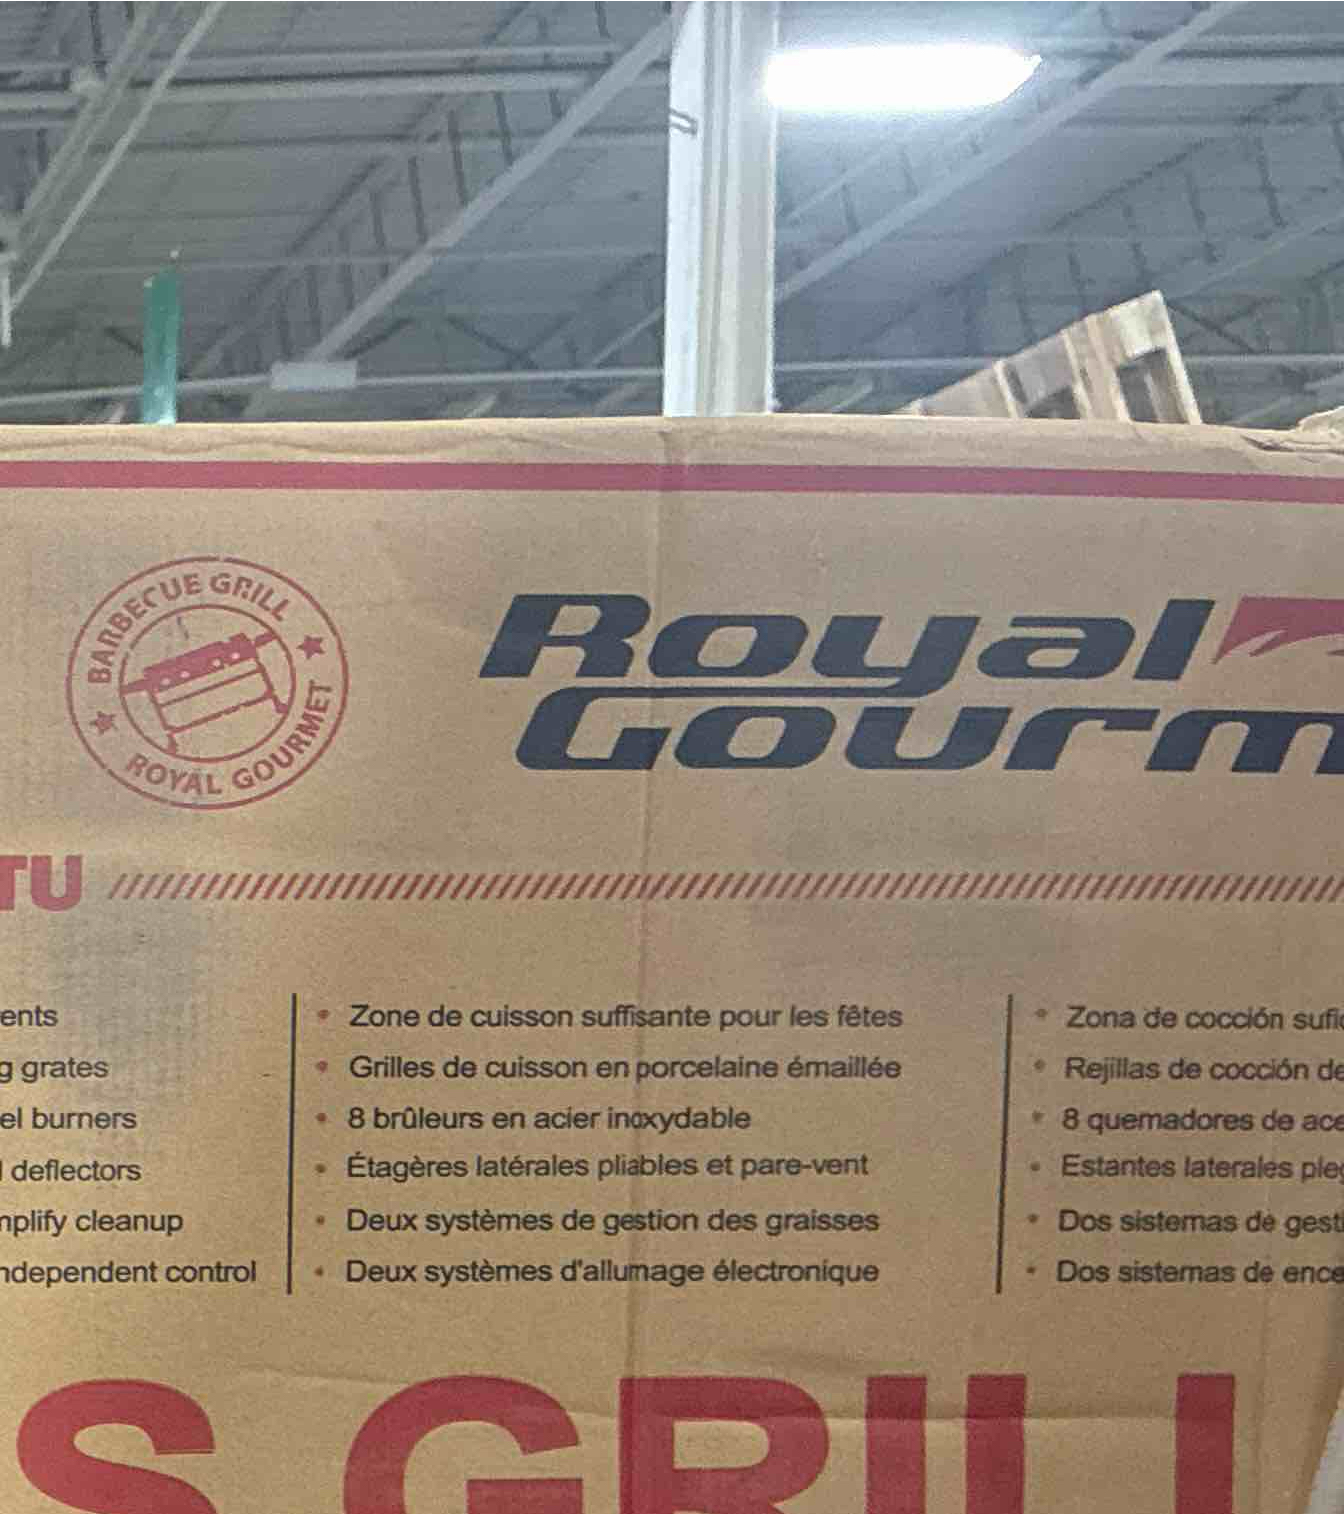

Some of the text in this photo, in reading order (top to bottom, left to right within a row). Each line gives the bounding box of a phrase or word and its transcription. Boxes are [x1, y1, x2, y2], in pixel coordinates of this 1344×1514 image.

[88, 571, 291, 684] BARBECUE GRILL
[479, 593, 1216, 698] Royal
[124, 680, 333, 796] ROYAL GOURMET
[515, 686, 1344, 774] Gourm
[350, 1004, 904, 1031] Zone de cuisson suffisante pour les fêtes
[1067, 1005, 1136, 1029] Zona
[1143, 1006, 1177, 1029] de
[1185, 1006, 1284, 1030] cocción
[22, 1057, 109, 1083] grates
[350, 1056, 902, 1083] Grilles de cuisson en porcelaine émaillée
[1065, 1057, 1161, 1086] Rejillas
[1168, 1057, 1202, 1080] de
[1210, 1057, 1309, 1081] cocción
[32, 1108, 137, 1130] burners
[348, 1106, 752, 1134] 8 brûleurs en acier inoxydable
[1062, 1108, 1080, 1130] 8
[1087, 1108, 1254, 1135] quemadores
[1262, 1108, 1295, 1131] de
[12, 1159, 142, 1182] deflectors
[347, 1151, 869, 1183] Étagères latérales pliables et pare-vent
[1061, 1154, 1176, 1179] Estantes
[1184, 1154, 1293, 1179] laterales
[76, 1210, 183, 1236] cleanup
[347, 1209, 879, 1237] Deux systèmes de gestion des graisses
[1058, 1209, 1112, 1232] Dos
[1120, 1209, 1237, 1233] sistemas
[1245, 1210, 1276, 1232] de
[165, 1260, 257, 1283] control
[346, 1259, 879, 1287] Deux systèmes d'allumage électronique
[1056, 1260, 1111, 1283] Dos
[1118, 1260, 1236, 1283] sistemas
[1244, 1260, 1275, 1283] de
